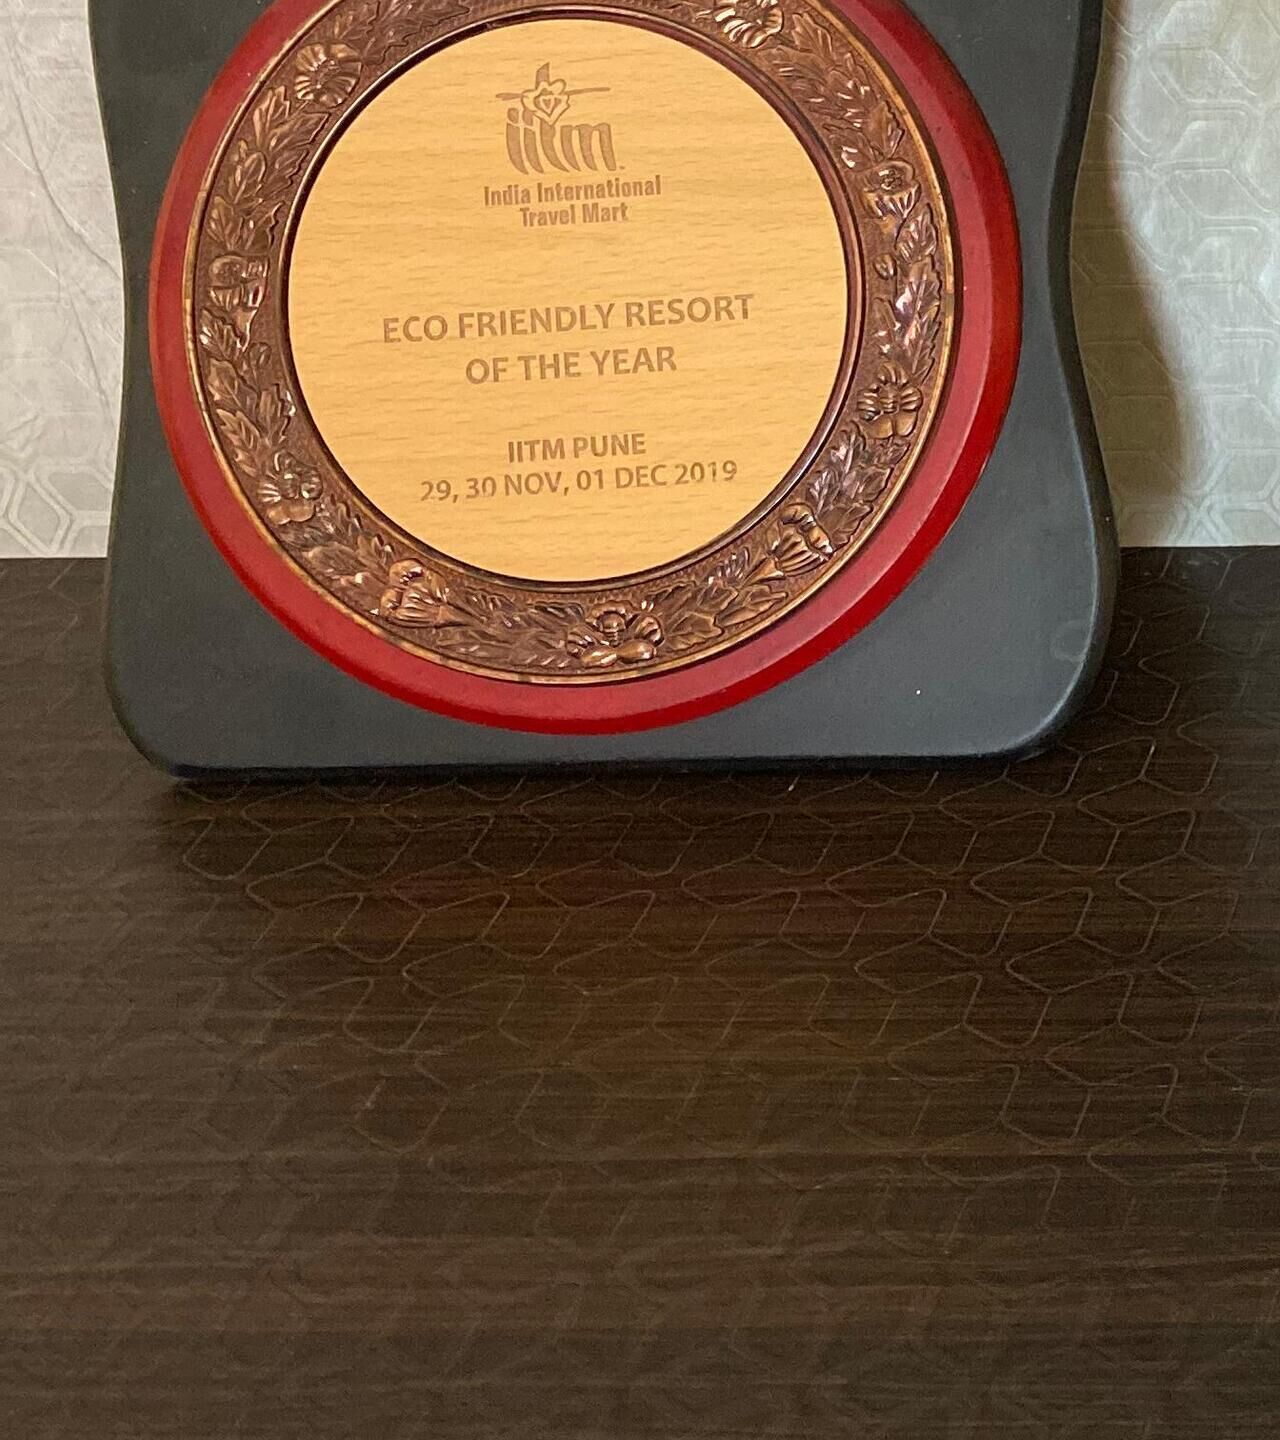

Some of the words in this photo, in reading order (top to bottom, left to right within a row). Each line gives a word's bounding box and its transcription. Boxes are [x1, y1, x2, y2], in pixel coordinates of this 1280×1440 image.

[484, 185, 531, 206] India
[538, 175, 661, 201] International
[520, 204, 575, 227] Travel
[583, 202, 628, 223] Mart
[383, 315, 448, 343] ECO
[459, 303, 614, 339] FRIENDLY
[625, 294, 753, 327] RESORT
[466, 357, 509, 384] OF
[518, 351, 581, 381] THE
[590, 346, 677, 376] YEAR
[508, 438, 565, 463] IITM
[573, 433, 646, 458] PUNE
[420, 479, 459, 503] 29,
[467, 476, 497, 500] 30
[505, 471, 569, 496] NOV,
[576, 468, 602, 491] 01
[616, 463, 667, 489] DEC
[675, 460, 738, 485] 2019
